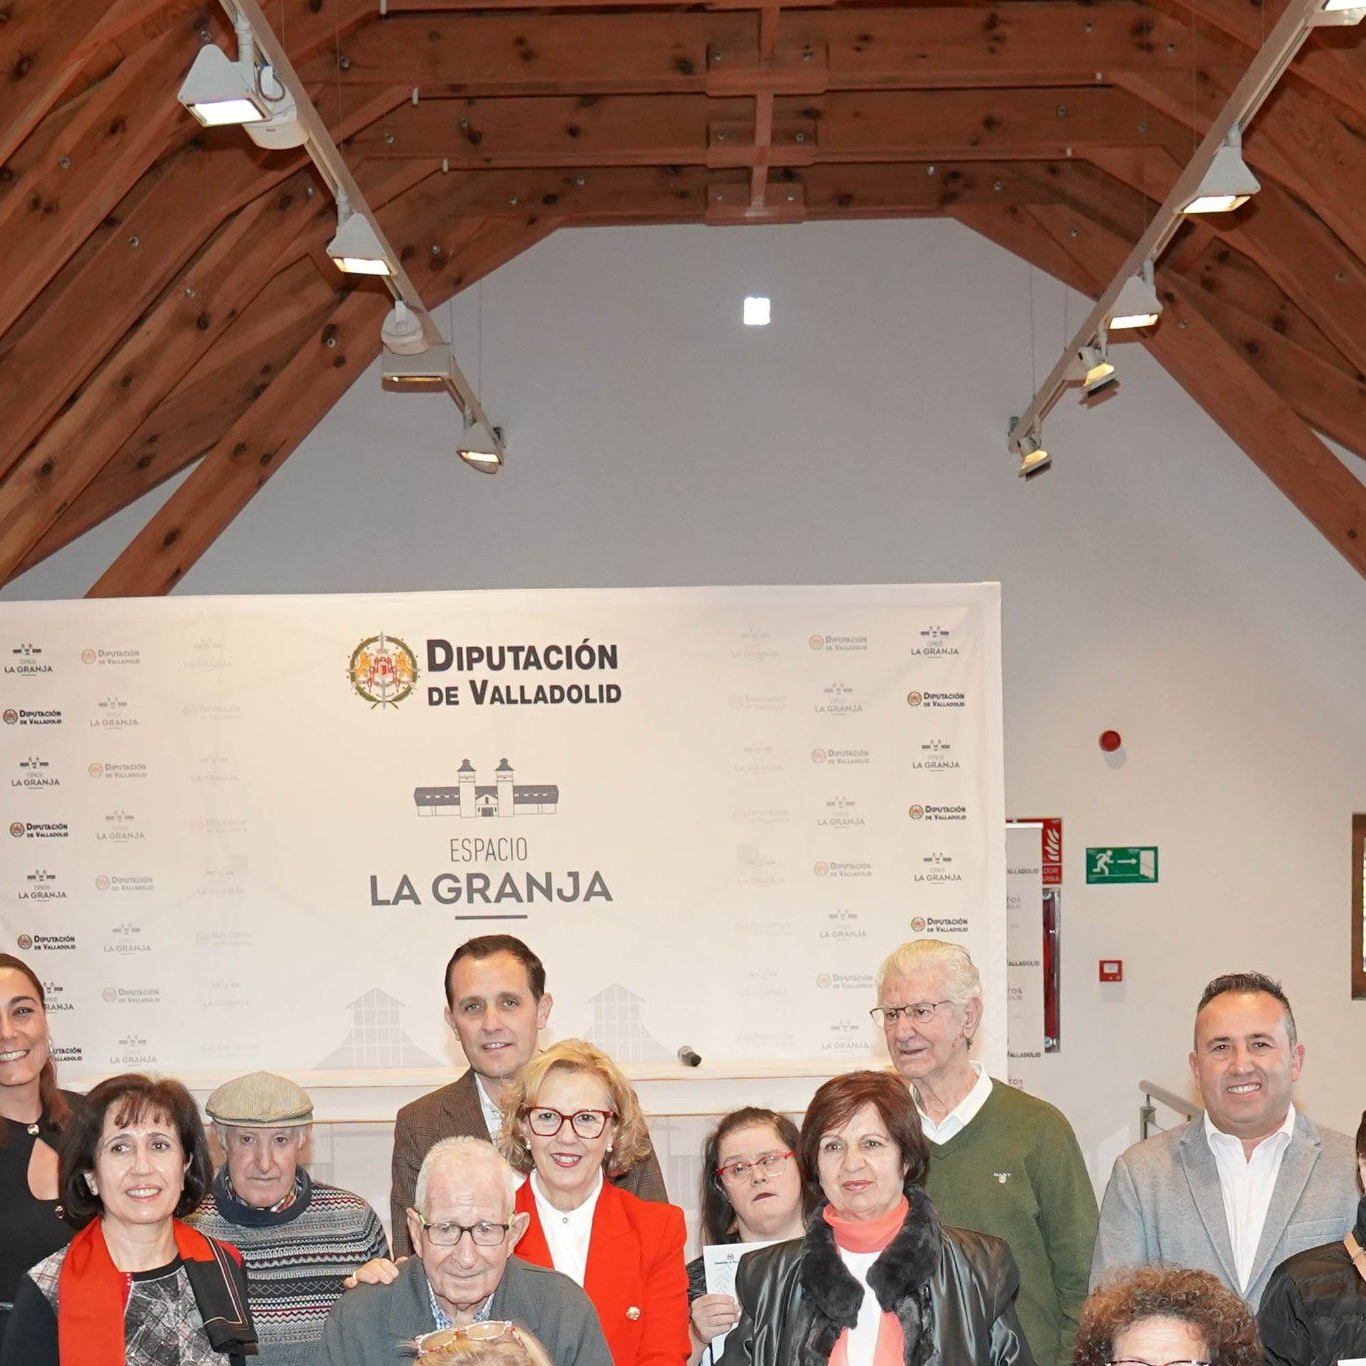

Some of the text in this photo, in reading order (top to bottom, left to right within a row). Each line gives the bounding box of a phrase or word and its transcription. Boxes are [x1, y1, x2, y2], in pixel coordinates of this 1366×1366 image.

[427, 639, 618, 672] DIPUTACIÓN
[428, 679, 621, 706] DE VALLADOLID
[450, 837, 528, 862] ESPACIO
[370, 870, 613, 906] LA GRANJA
